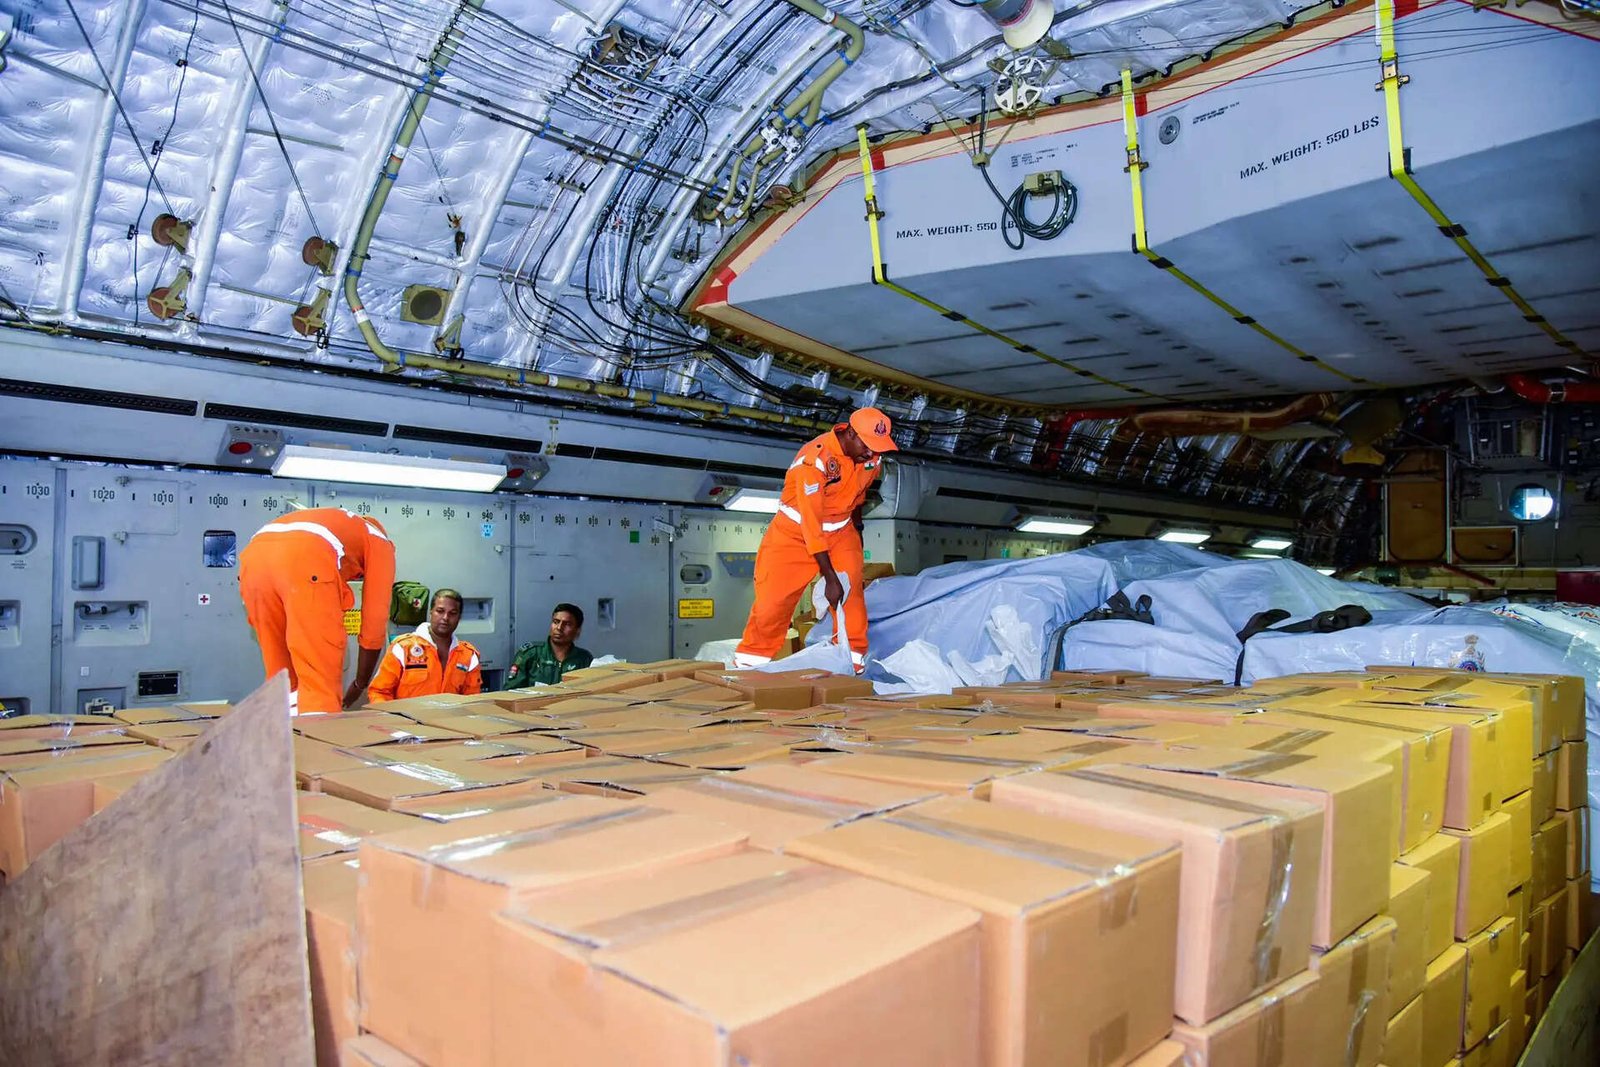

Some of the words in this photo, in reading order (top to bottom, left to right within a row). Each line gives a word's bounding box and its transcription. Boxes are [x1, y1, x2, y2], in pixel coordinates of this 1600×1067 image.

[1240, 161, 1268, 179] MAX.
[1271, 139, 1321, 166] WEIGHT:
[1326, 128, 1349, 145] 550
[1354, 115, 1379, 134] LBS
[896, 228, 923, 239] MAX.
[927, 224, 972, 236] WEIGHT:
[976, 221, 997, 231] 550
[26, 485, 50, 496] 1030
[92, 489, 115, 500] 1020
[153, 493, 174, 503] 1010
[208, 496, 228, 506] 1000
[263, 498, 278, 508] 990
[357, 503, 371, 513] 970
[401, 506, 414, 516] 960
[443, 508, 455, 518] 950
